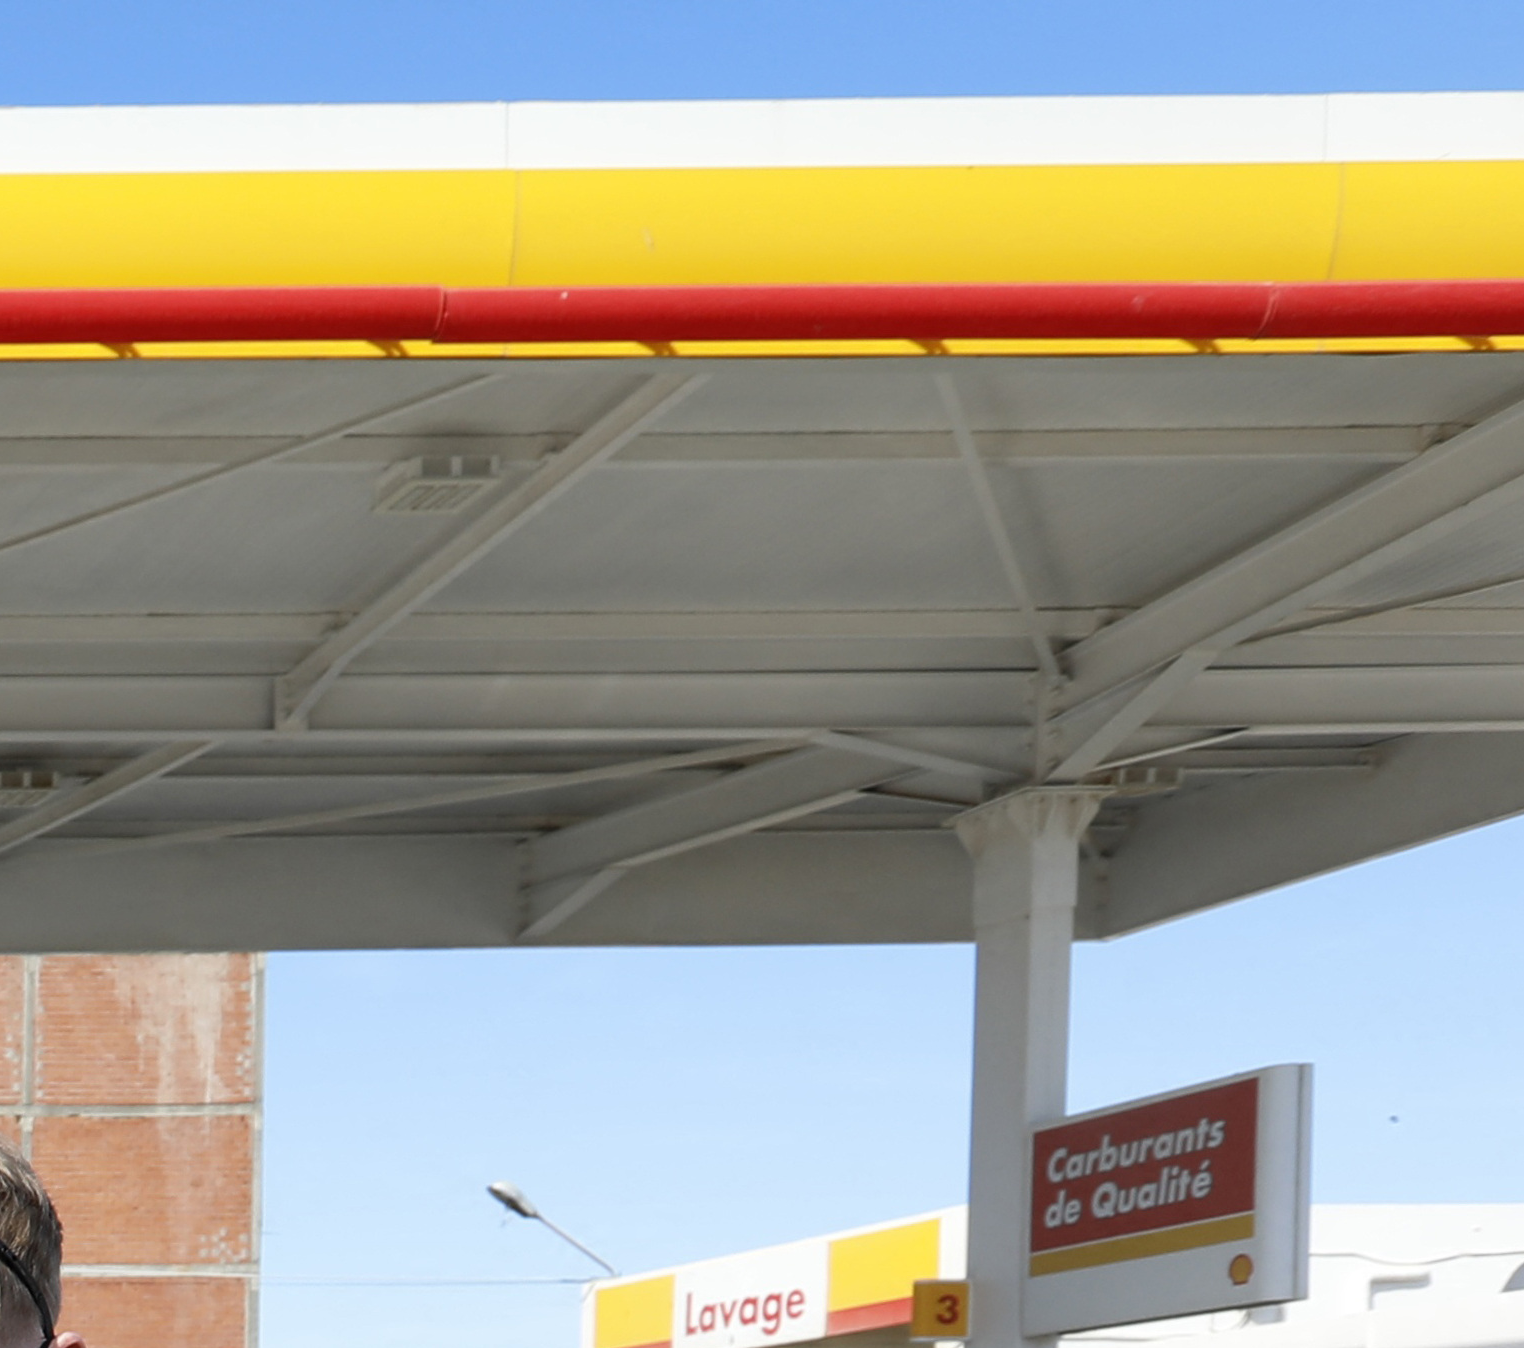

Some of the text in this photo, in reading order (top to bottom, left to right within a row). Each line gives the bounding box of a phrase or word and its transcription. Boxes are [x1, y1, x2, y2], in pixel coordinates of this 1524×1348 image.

[1047, 1117, 1226, 1183] Carburants
[1044, 1159, 1213, 1229] de Qualité
[686, 1288, 806, 1336] Lavage
[936, 1294, 960, 1325] 3
